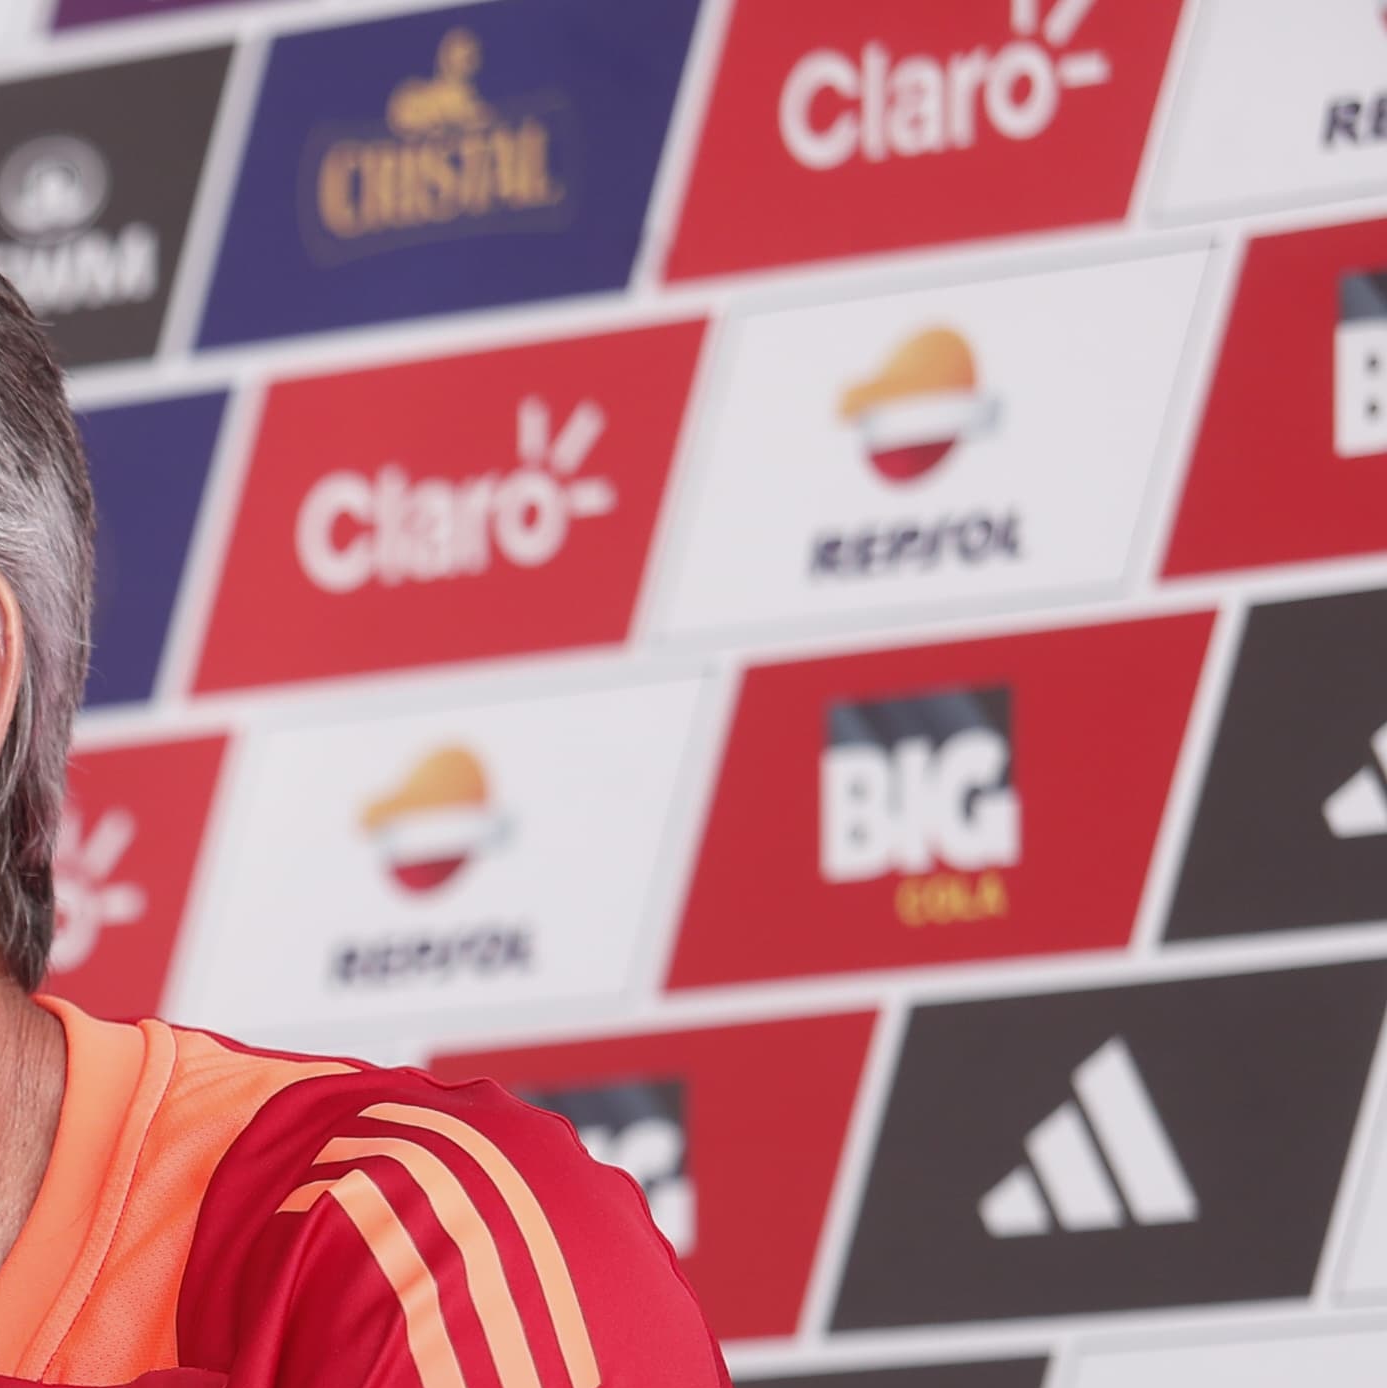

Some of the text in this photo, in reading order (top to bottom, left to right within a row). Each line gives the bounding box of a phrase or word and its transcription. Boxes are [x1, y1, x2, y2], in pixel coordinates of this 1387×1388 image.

[777, 38, 1059, 170] Claro
[317, 122, 562, 240] CRISTAL
[293, 460, 569, 594] Claro
[807, 507, 1024, 580] REPSOL
[818, 728, 1022, 884] BIG
